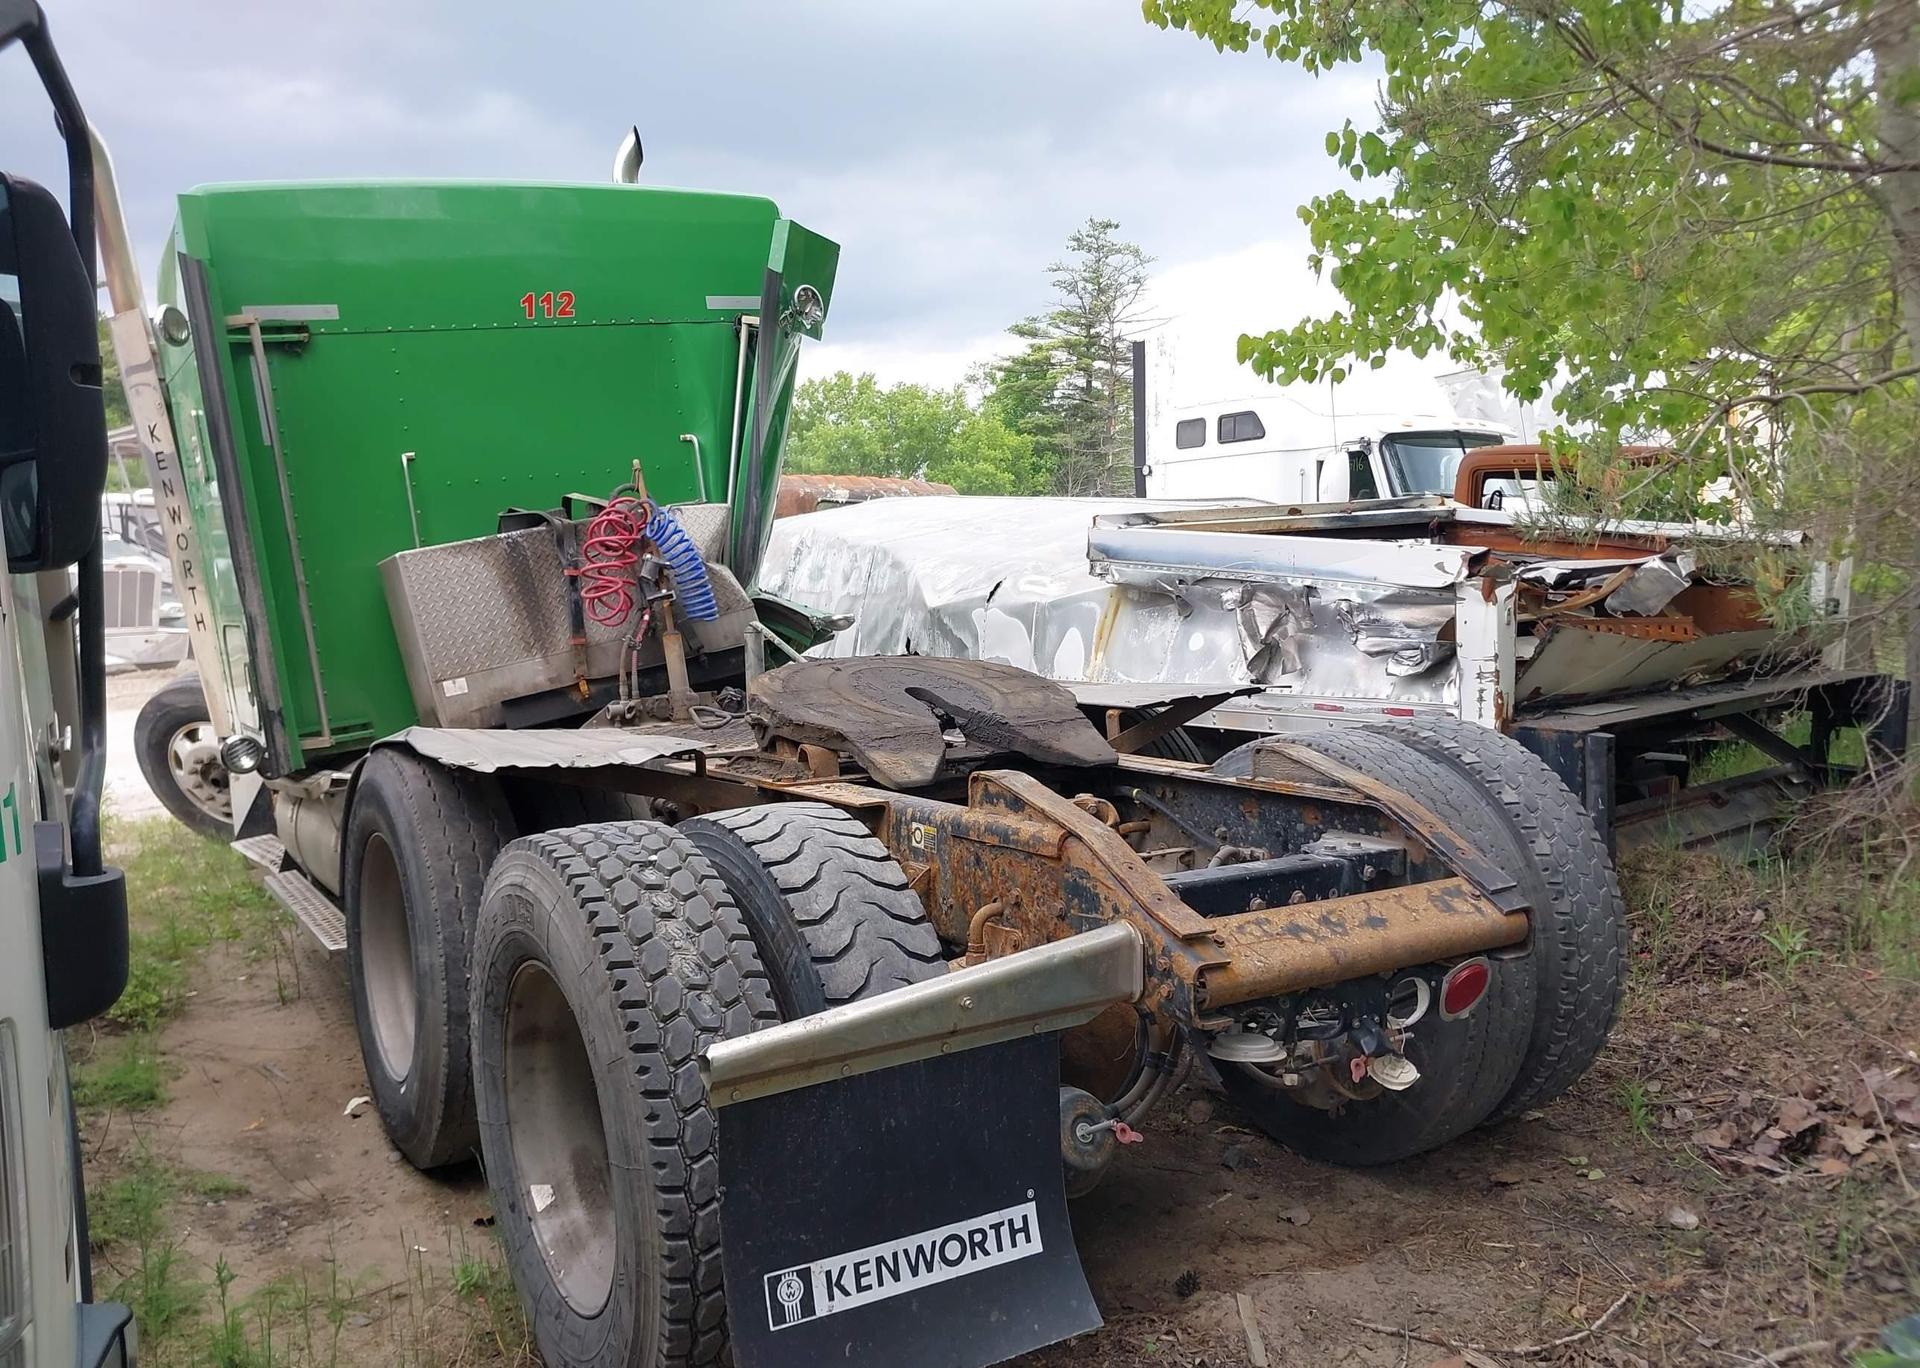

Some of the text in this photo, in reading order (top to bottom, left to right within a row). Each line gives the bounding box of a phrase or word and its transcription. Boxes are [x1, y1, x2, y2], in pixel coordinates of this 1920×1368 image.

[520, 291, 576, 319] 112
[148, 423, 207, 632] KENWORTH
[825, 1214, 1032, 1302] KENWORTH
